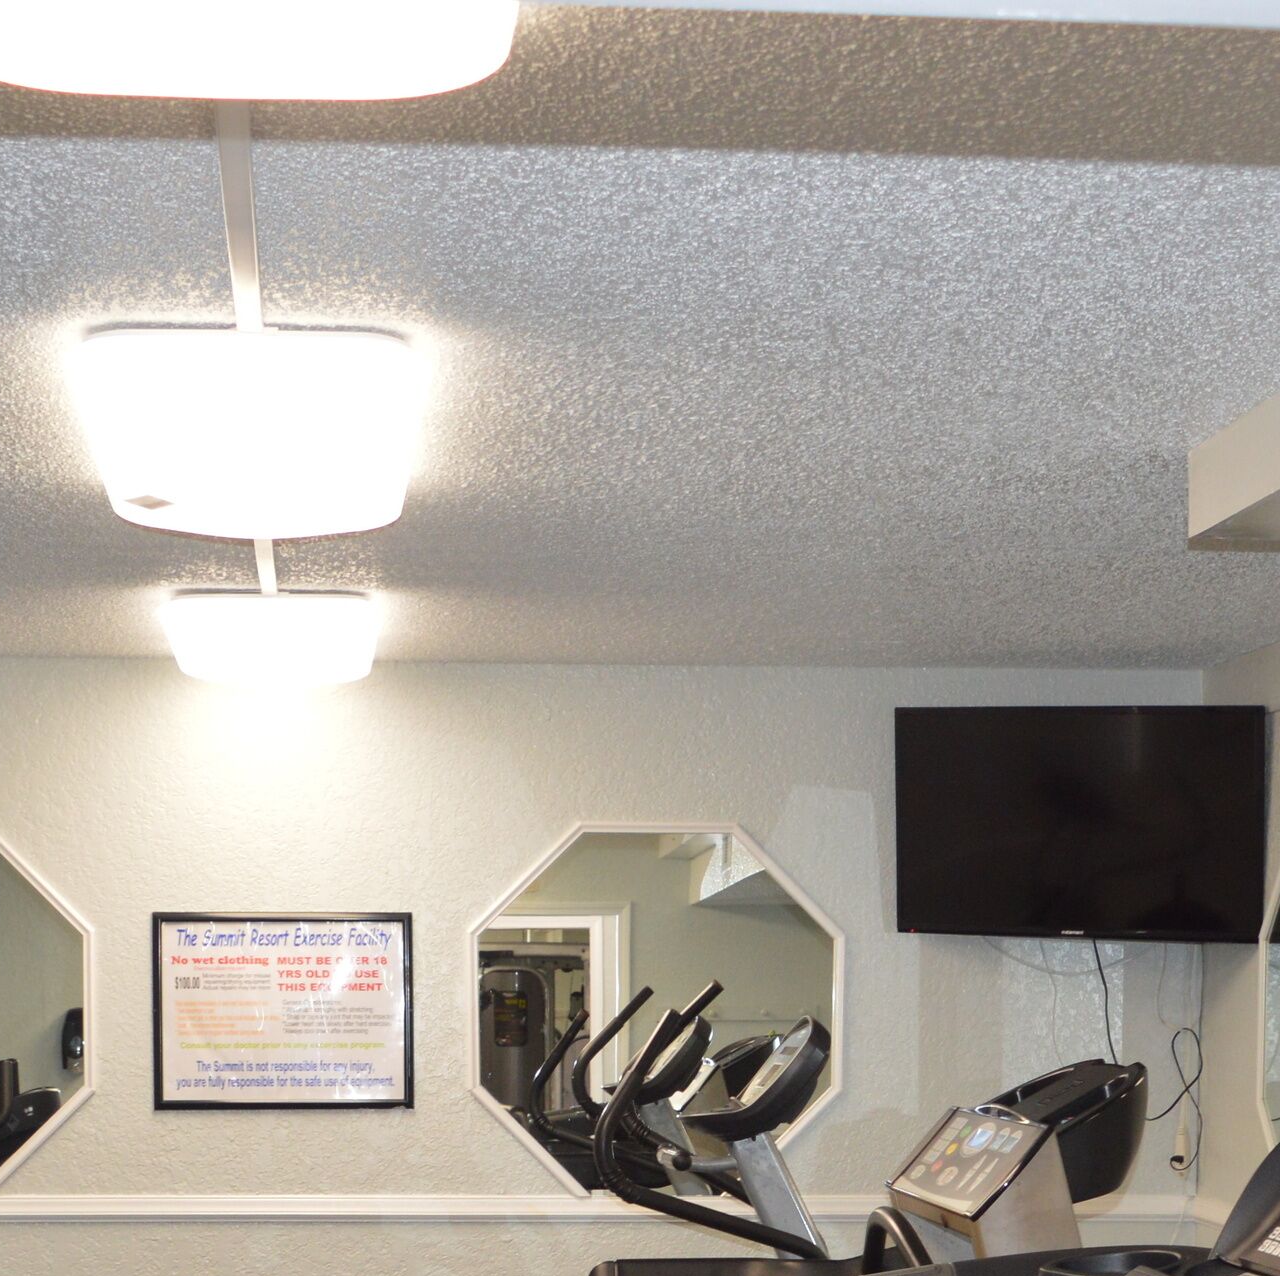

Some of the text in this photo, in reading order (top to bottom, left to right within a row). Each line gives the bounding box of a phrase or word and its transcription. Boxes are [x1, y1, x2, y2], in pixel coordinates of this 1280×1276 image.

[176, 928, 392, 951] The Summit Resort Exercise Facility
[171, 956, 270, 967] No wet clothing
[276, 956, 312, 965] MUST
[316, 956, 332, 965] BE
[278, 970, 302, 978] YRS
[306, 970, 330, 978] OLD
[355, 970, 380, 978] USE
[278, 983, 306, 992] THIS
[196, 1060, 212, 1072] The
[214, 1060, 244, 1072] Summit
[246, 1061, 254, 1072] is
[255, 1062, 269, 1072] not
[271, 1061, 317, 1074] responsible
[320, 1061, 331, 1072] for
[334, 1063, 348, 1074] any
[176, 1078, 192, 1090] you
[193, 1078, 207, 1088] are
[208, 1076, 226, 1090] fully
[227, 1076, 274, 1090] responsible
[276, 1076, 288, 1087] for
[290, 1076, 302, 1087] the
[304, 1076, 320, 1087] safe
[324, 1078, 337, 1087] use
[340, 1076, 349, 1087] of
